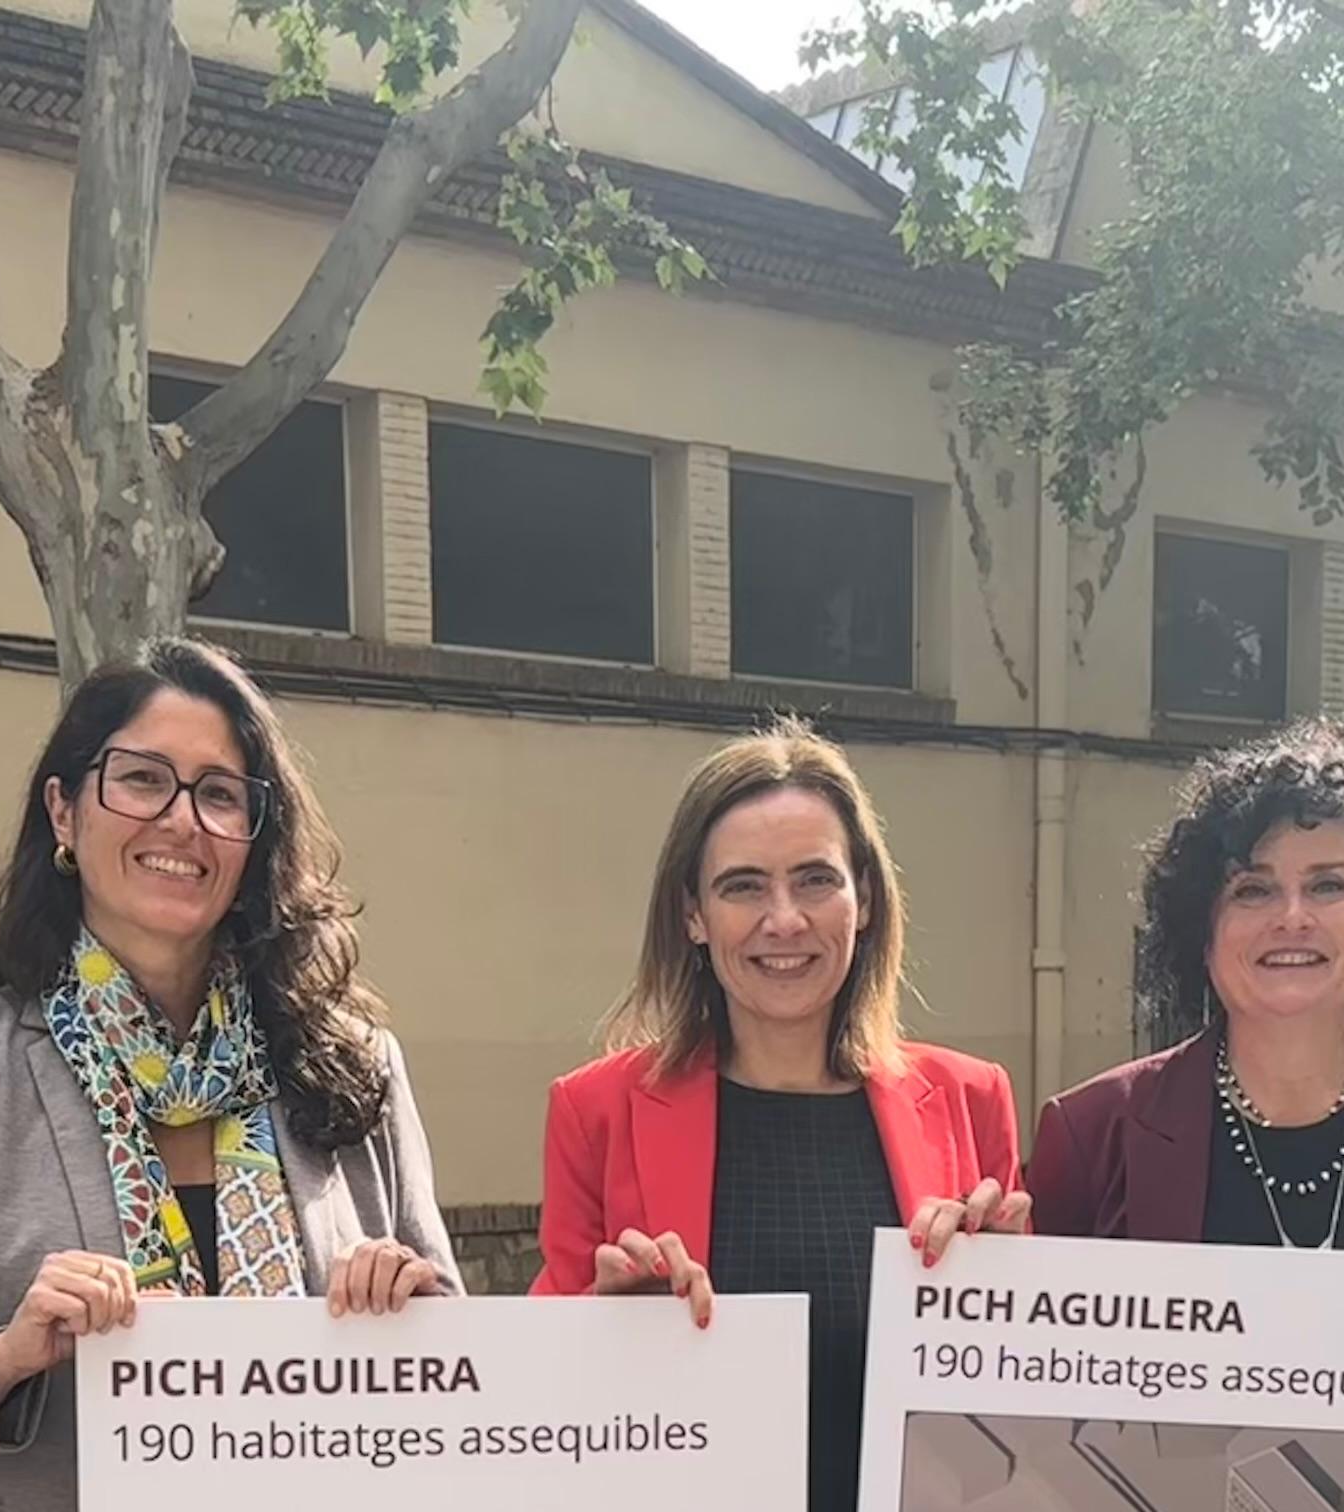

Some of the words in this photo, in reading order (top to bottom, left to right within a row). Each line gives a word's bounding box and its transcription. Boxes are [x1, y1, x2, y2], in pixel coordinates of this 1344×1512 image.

[915, 1285, 1014, 1323] PICH
[1027, 1291, 1245, 1334] AGUILERA
[111, 1359, 225, 1397] PICH
[240, 1356, 481, 1396] AGUILERA
[912, 1343, 984, 1379] 190
[997, 1345, 1208, 1398] habitatges
[112, 1423, 194, 1462] 190
[211, 1420, 445, 1468] habitatges
[459, 1413, 709, 1464] assequibles
